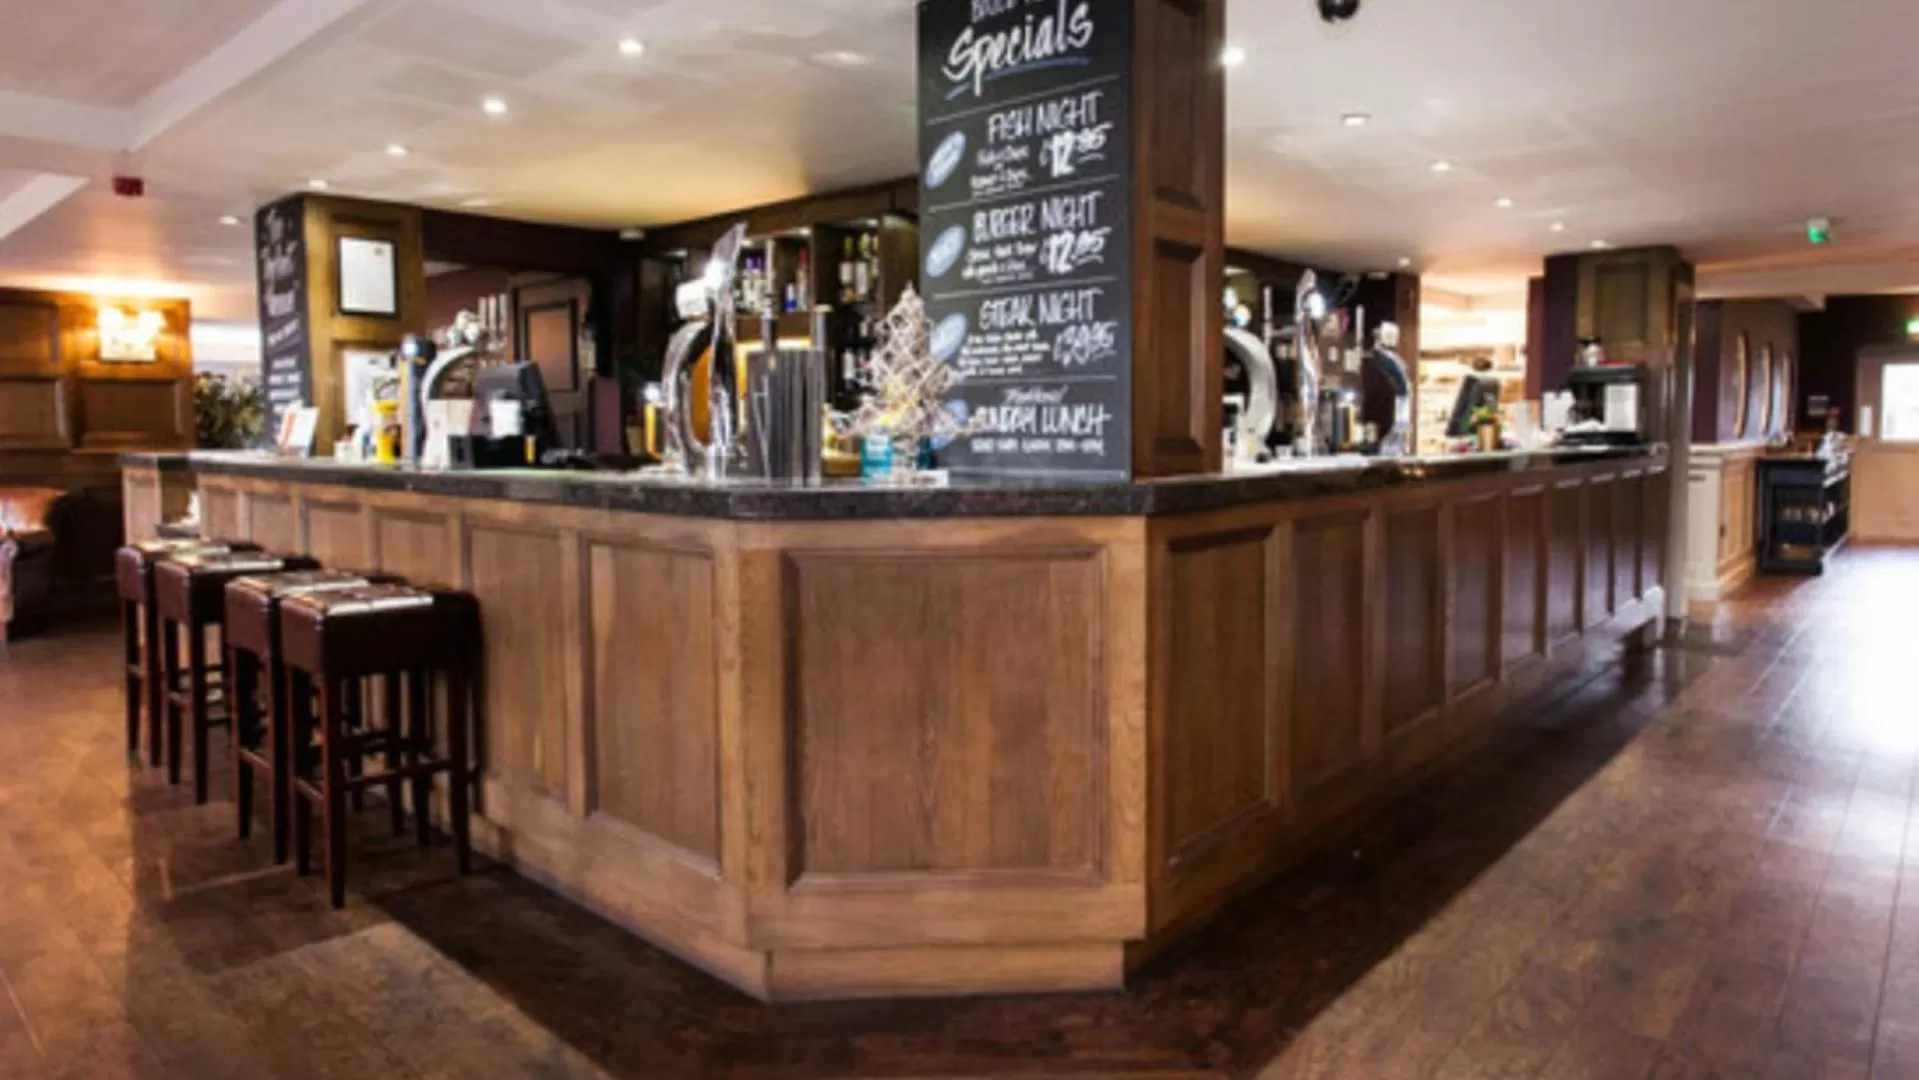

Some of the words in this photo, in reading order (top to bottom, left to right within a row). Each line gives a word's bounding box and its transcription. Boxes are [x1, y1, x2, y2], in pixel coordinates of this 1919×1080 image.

[941, 0, 1094, 97] Specials
[987, 105, 1033, 145] FISH
[1036, 91, 1103, 135] NIGHT
[972, 202, 1036, 244] BURGER
[1040, 191, 1104, 231] NIGHT
[978, 294, 1036, 331] STEAK
[1038, 288, 1104, 325] NIGHT
[1041, 403, 1112, 436] LUNCH
